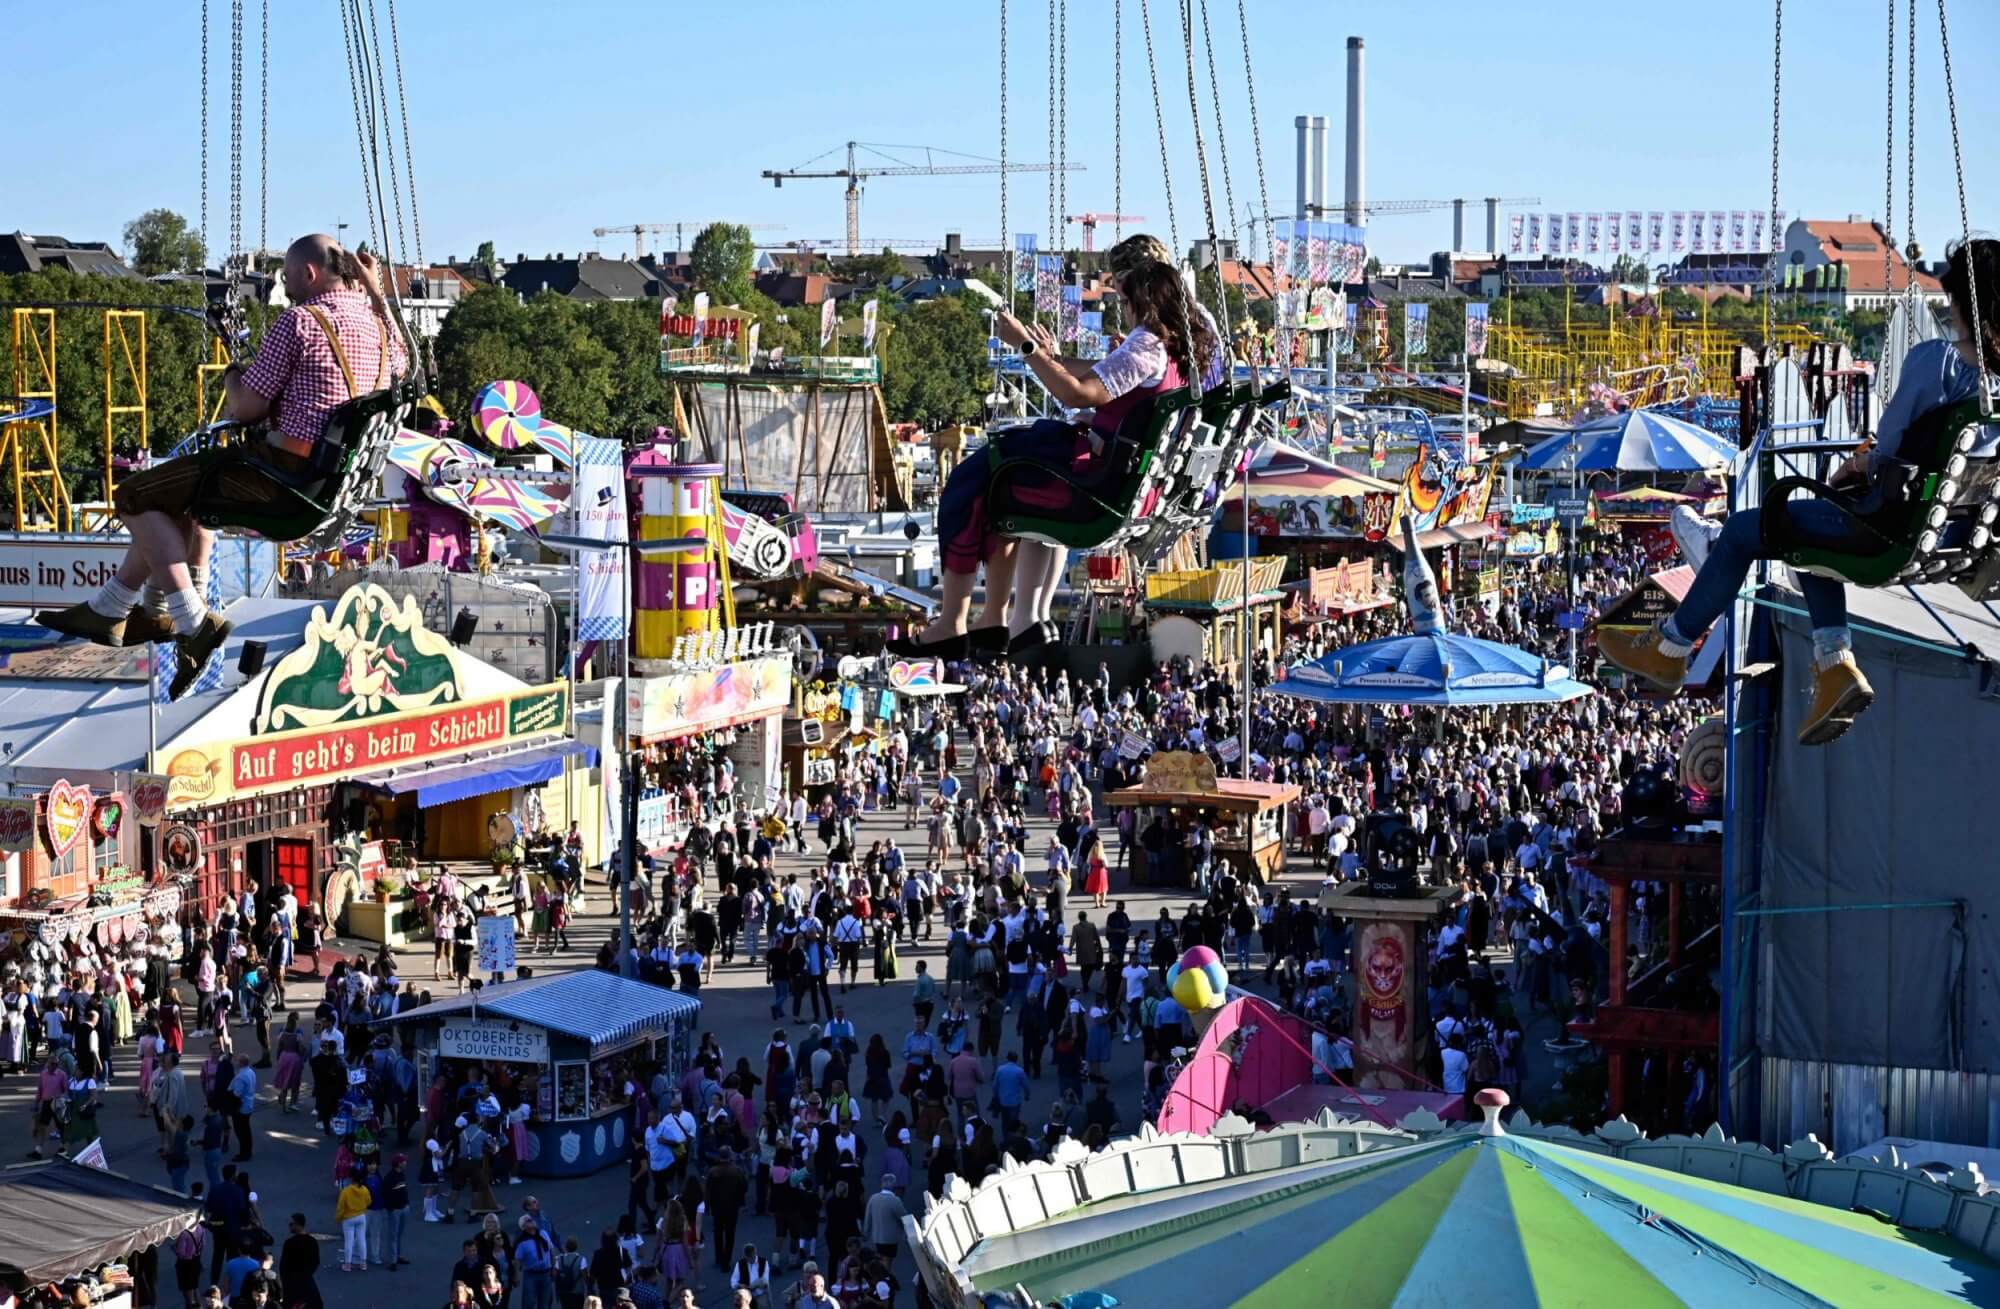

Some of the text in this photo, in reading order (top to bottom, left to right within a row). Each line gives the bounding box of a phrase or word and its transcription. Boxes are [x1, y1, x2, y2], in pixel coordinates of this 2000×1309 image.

[683, 482, 708, 605] TOP
[38, 560, 65, 590] im
[72, 559, 117, 587] Schi
[1643, 590, 1666, 600] EIS
[238, 747, 276, 781] Auf
[291, 735, 354, 776] geht's
[367, 728, 415, 759] beim
[428, 705, 501, 748] Schichtl
[443, 1028, 543, 1046] OKTOBERFEST
[456, 1043, 530, 1058] SOUVENIRS
